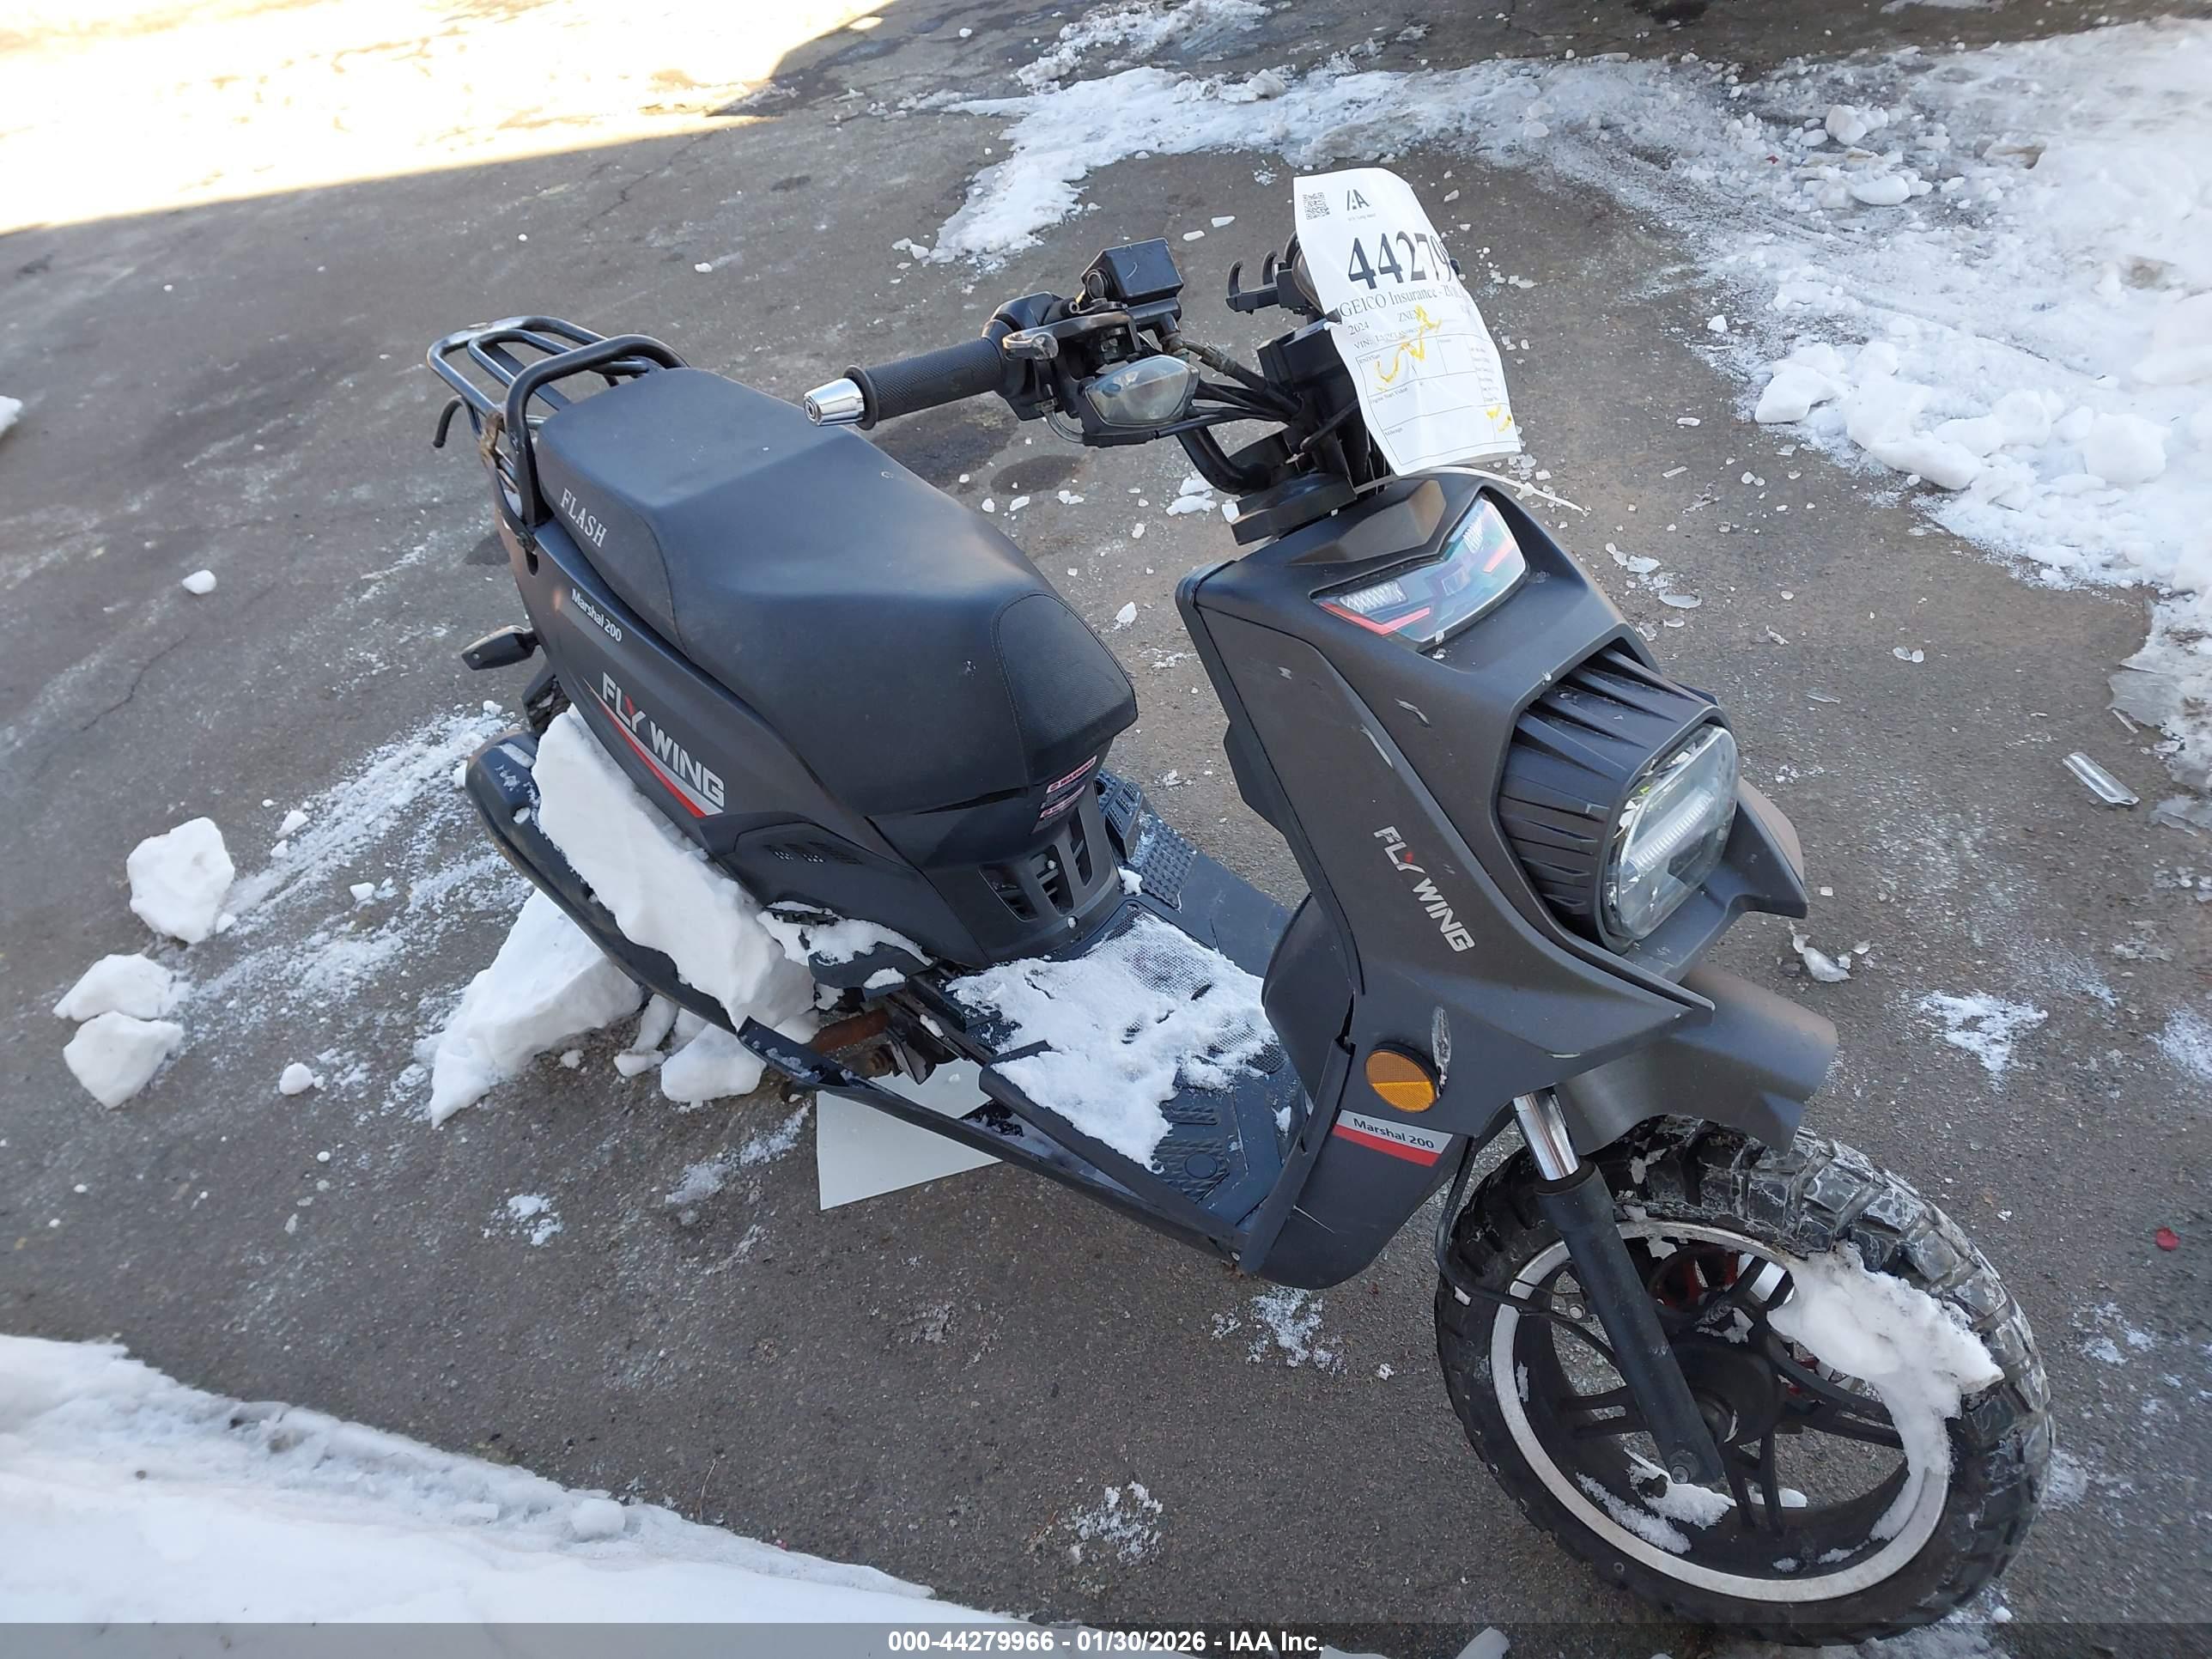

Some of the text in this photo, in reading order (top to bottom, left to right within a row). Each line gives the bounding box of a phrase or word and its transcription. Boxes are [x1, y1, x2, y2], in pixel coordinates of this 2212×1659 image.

[1340, 293, 1387, 318] GEICO
[1388, 288, 1437, 306] Insurance
[1347, 320, 1370, 336] 2024
[560, 487, 607, 548] FLASH
[571, 587, 623, 642] Marshal 200
[602, 672, 725, 808] FLY WING
[1374, 825, 1475, 952] FLY WING
[1353, 1117, 1435, 1149] Marshal 200
